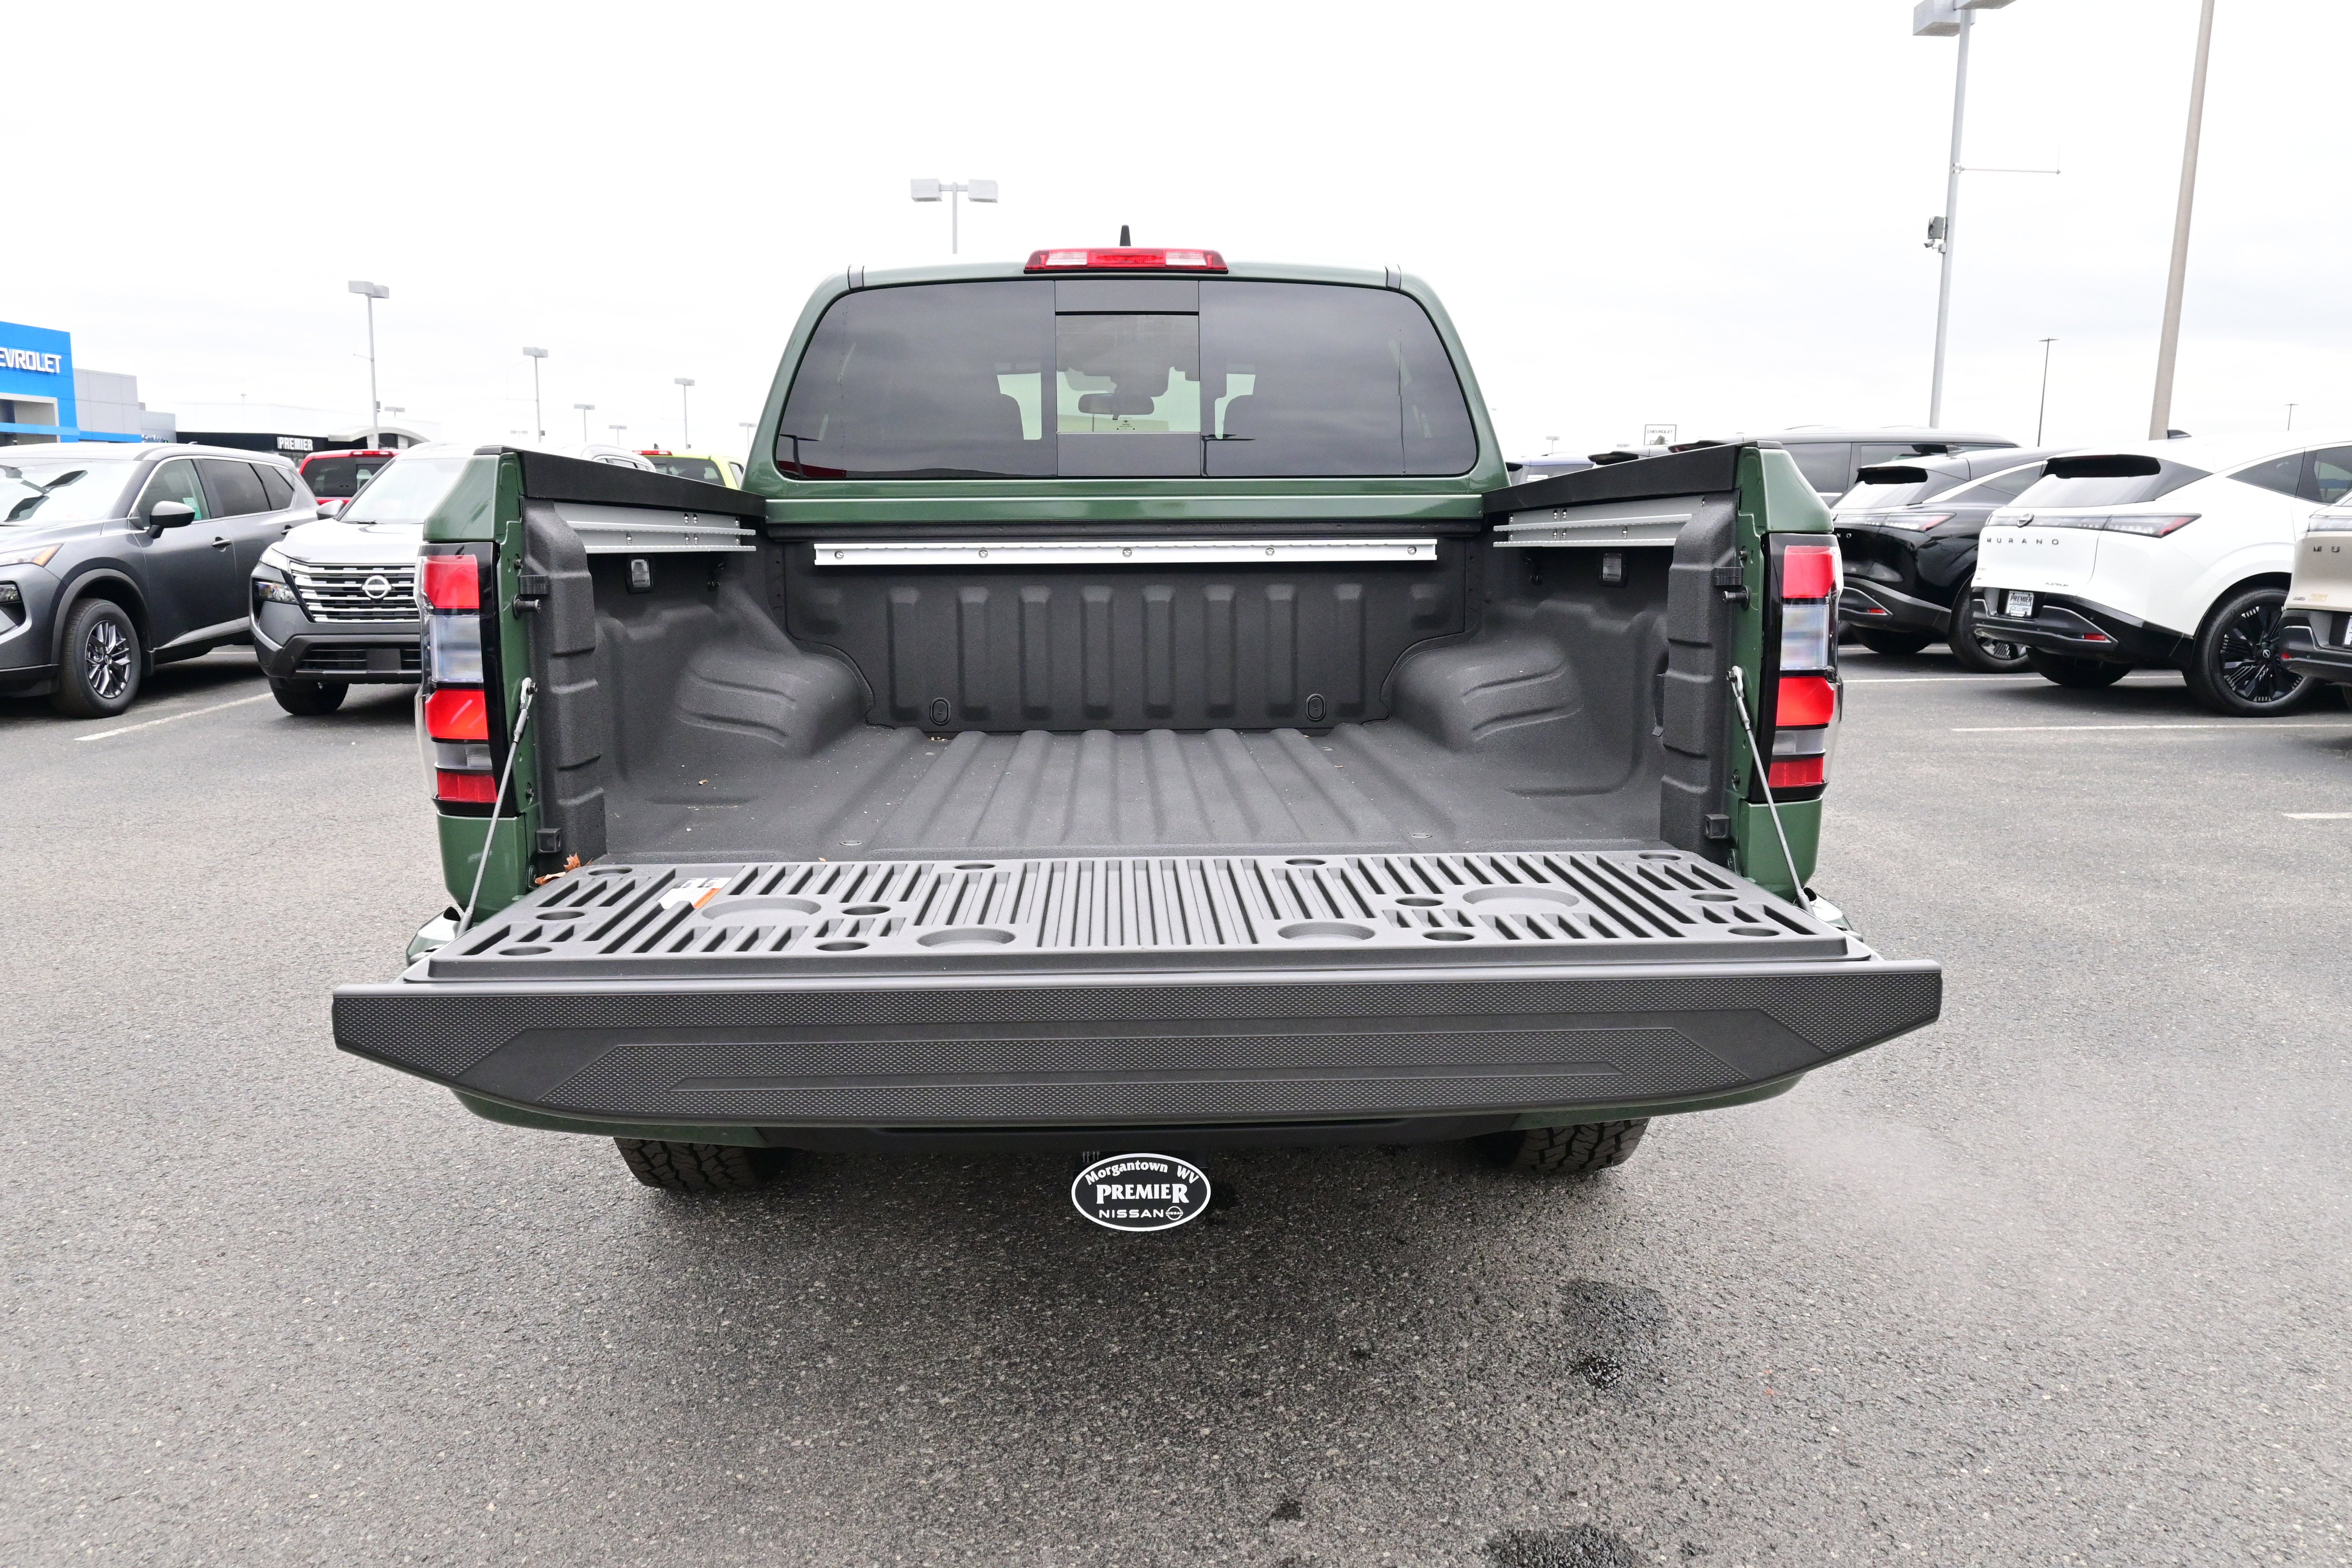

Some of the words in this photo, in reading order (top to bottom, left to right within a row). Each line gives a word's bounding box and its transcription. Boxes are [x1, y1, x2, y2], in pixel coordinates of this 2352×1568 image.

[277, 436, 313, 451] PREMIER
[1085, 1160, 1168, 1185] Morgantown
[1177, 1165, 1199, 1184] WV
[1096, 1184, 1190, 1204] PREMIER
[1099, 1209, 1164, 1218] NISSAN
